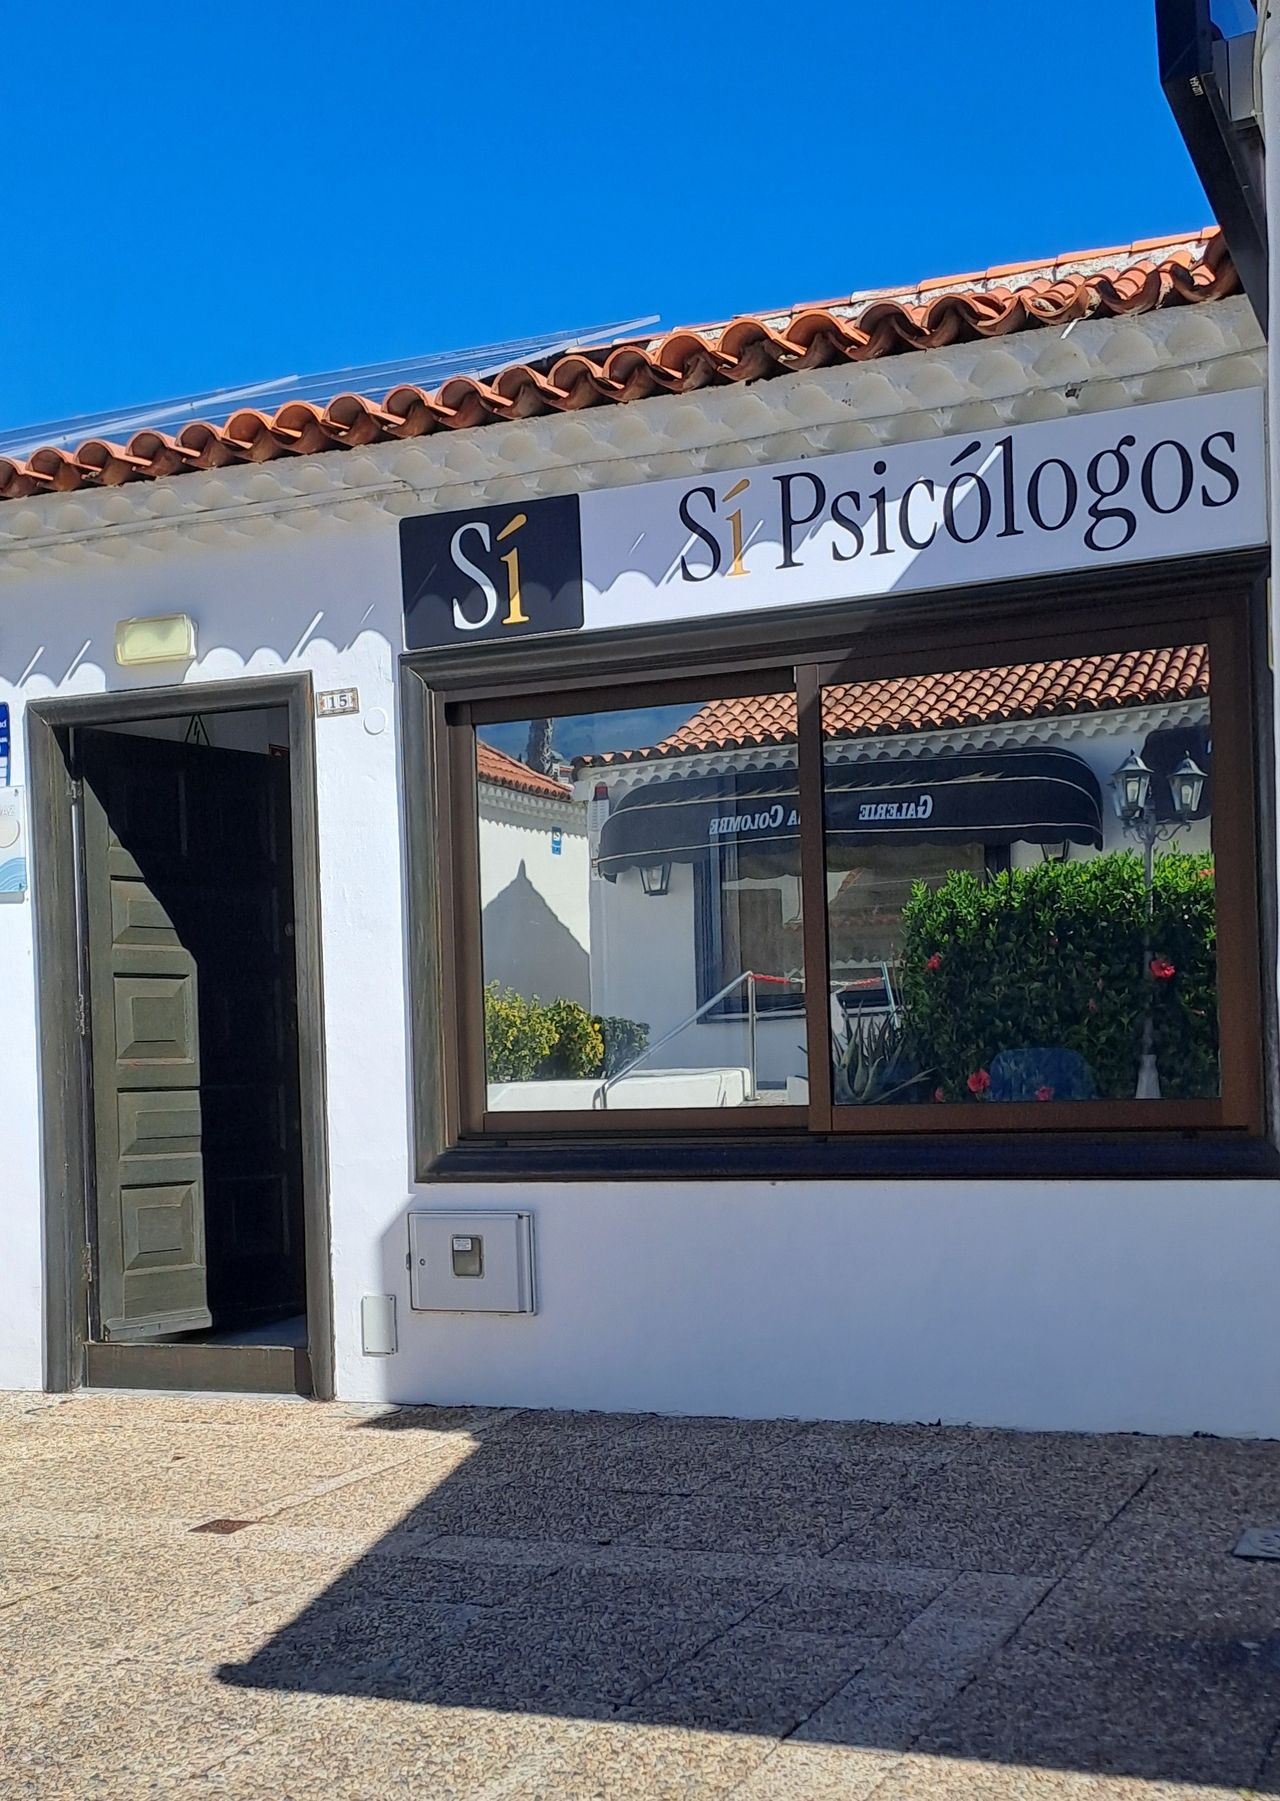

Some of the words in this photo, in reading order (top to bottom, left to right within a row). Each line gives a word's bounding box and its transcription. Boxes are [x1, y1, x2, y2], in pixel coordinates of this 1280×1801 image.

[679, 478, 751, 583] Sí
[773, 430, 1238, 569] Psicólogos
[451, 513, 529, 631] Sí
[329, 694, 348, 709] 15
